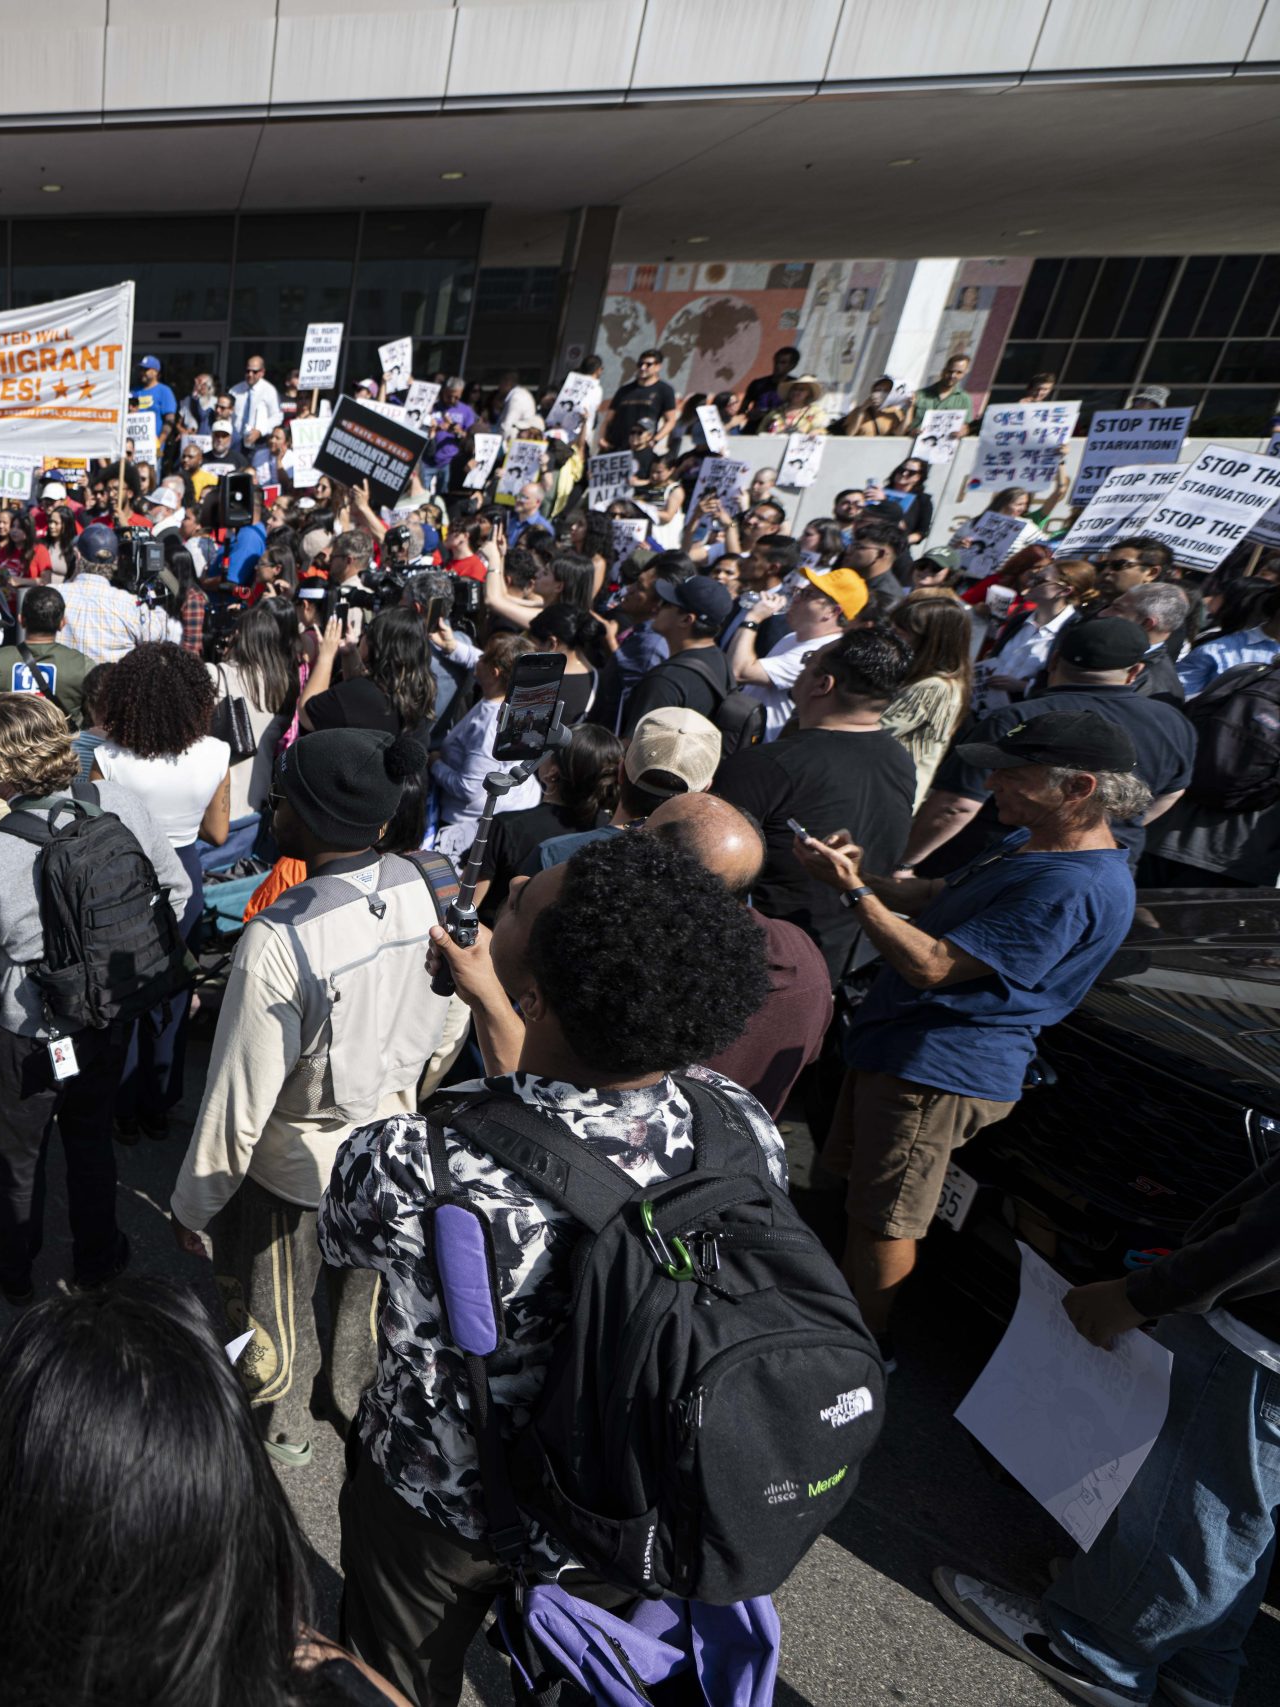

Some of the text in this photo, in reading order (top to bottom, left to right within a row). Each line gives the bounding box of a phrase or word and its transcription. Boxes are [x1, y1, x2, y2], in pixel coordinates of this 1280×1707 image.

[35, 327, 74, 344] WILL
[306, 359, 332, 373] STOP
[1094, 416, 1186, 433] STOP THE
[330, 427, 410, 478] IMMIGRANTS ARE
[1088, 439, 1179, 451] STARVATION!
[325, 439, 405, 492] WELCOME HERE!
[590, 454, 631, 472] FREE
[1196, 455, 1251, 478] STOP
[591, 470, 631, 488] THEM
[1104, 471, 1181, 489] STOP THE
[1091, 492, 1166, 506] STARVATION!
[1178, 479, 1273, 509] STARVATION!
[1074, 517, 1116, 532] STOP
[1153, 508, 1206, 530] STOP
[1206, 519, 1248, 541] THE
[1138, 529, 1229, 556] DEPORATIONS!
[836, 1389, 858, 1405] THE
[820, 1402, 857, 1422] NORTH
[830, 1410, 858, 1429] FACE
[642, 1525, 656, 1581] CONNECTOR
